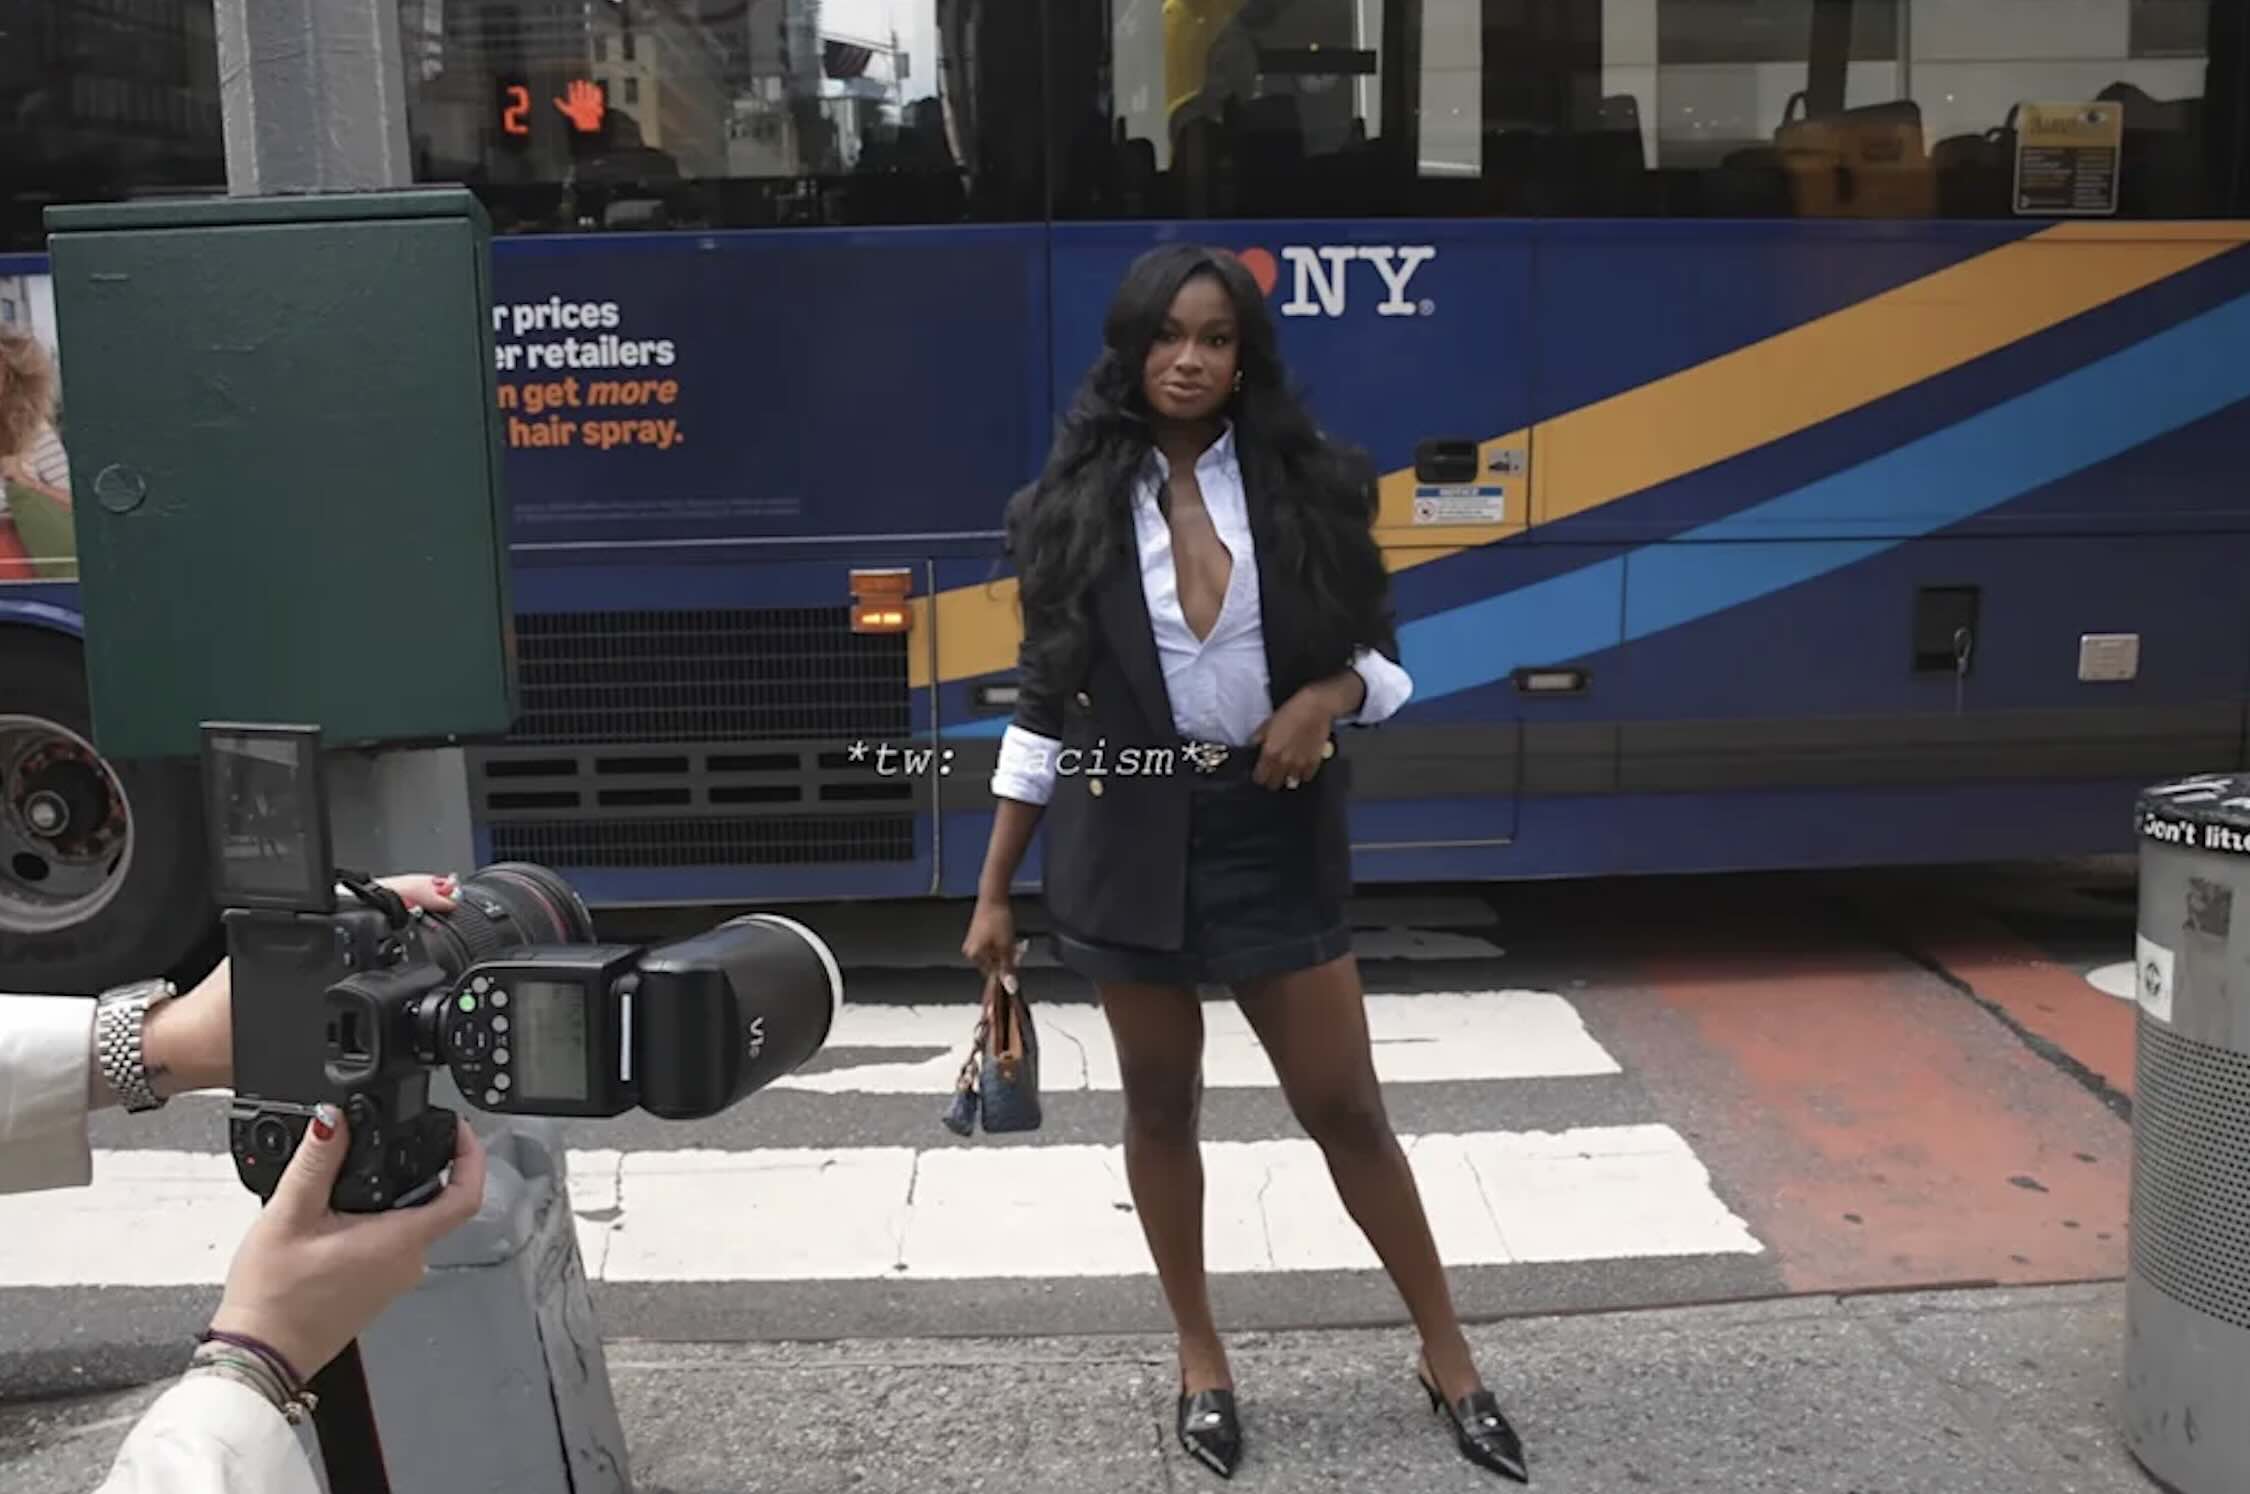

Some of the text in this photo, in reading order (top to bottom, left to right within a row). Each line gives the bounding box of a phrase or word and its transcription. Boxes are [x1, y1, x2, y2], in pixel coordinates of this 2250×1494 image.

[512, 296, 620, 337] prices
[526, 334, 676, 370] retailers
[522, 375, 582, 415] get
[586, 379, 679, 406] more
[508, 413, 685, 450] hair spray.
